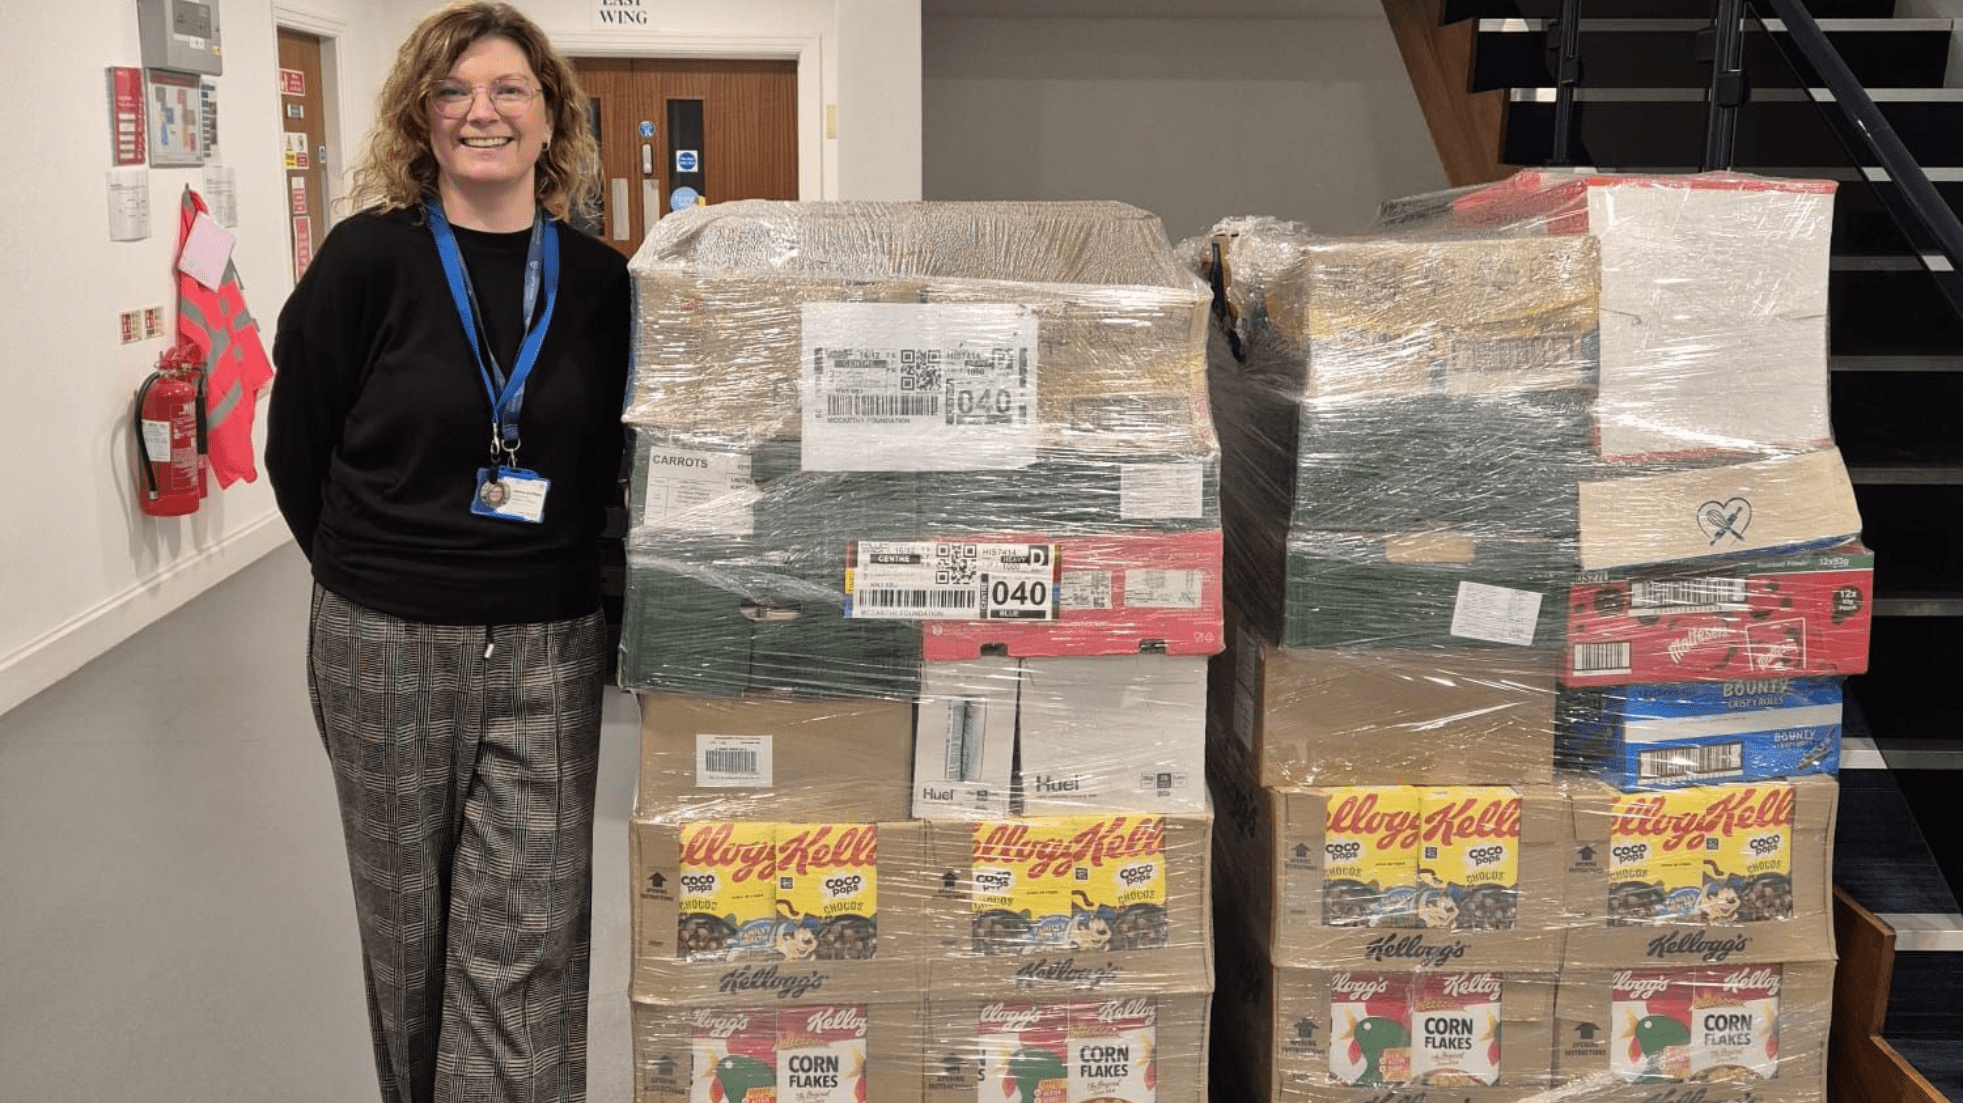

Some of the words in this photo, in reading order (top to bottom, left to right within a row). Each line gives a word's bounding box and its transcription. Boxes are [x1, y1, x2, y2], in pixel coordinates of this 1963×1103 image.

[600, 10, 647, 24] WING
[958, 389, 1012, 413] 040
[652, 454, 709, 469] CARROTS
[1030, 548, 1045, 566] D
[992, 581, 1046, 605] 040
[1723, 678, 1790, 697] BOUNTY
[1774, 730, 1816, 742] BOUNTY
[923, 787, 954, 801] Huel
[1365, 933, 1465, 967] Kellogg's
[1647, 931, 1748, 961] Kellogg's
[719, 965, 826, 998] Kellogg's
[1424, 1018, 1473, 1035] CORN
[1704, 1014, 1753, 1032] CORN
[1424, 1036, 1472, 1050] FLAKES
[1704, 1033, 1751, 1046] FLAKES
[1080, 1045, 1129, 1063] CORN
[789, 1055, 839, 1073] CORN
[1080, 1064, 1129, 1078] FLAKES
[789, 1075, 838, 1088] FLAKES
